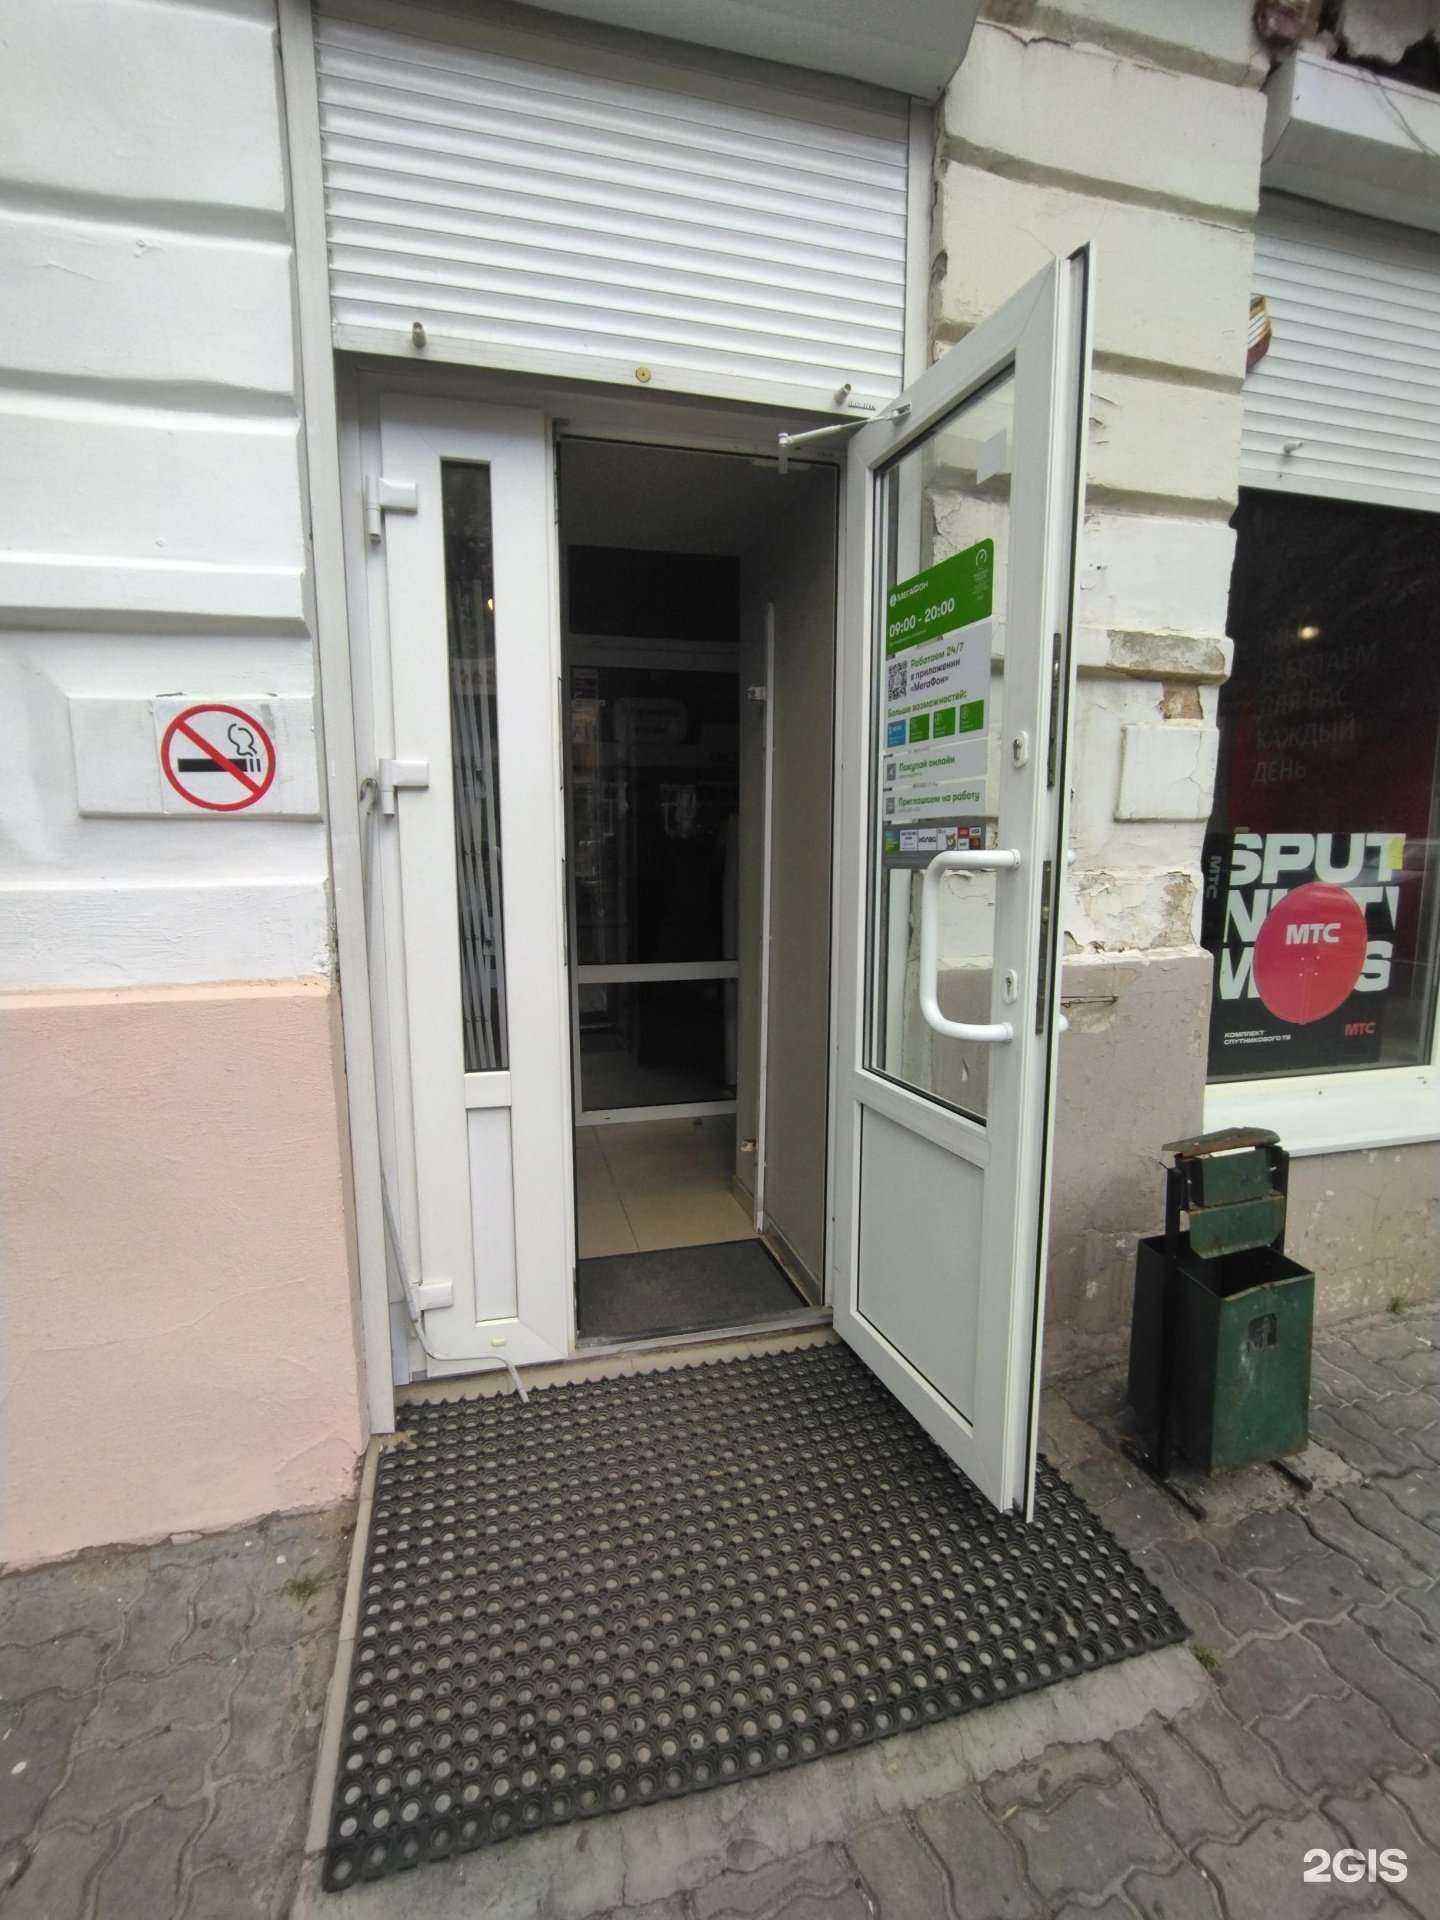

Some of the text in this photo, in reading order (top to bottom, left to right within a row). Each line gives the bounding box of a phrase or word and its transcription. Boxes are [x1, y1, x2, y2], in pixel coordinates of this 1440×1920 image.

[889, 614, 916, 637] 09:00
[924, 598, 955, 623] 20:00
[1252, 759, 1306, 786] ДЕНЬ
[952, 790, 980, 803] работу
[1229, 832, 1406, 886] SPUT
